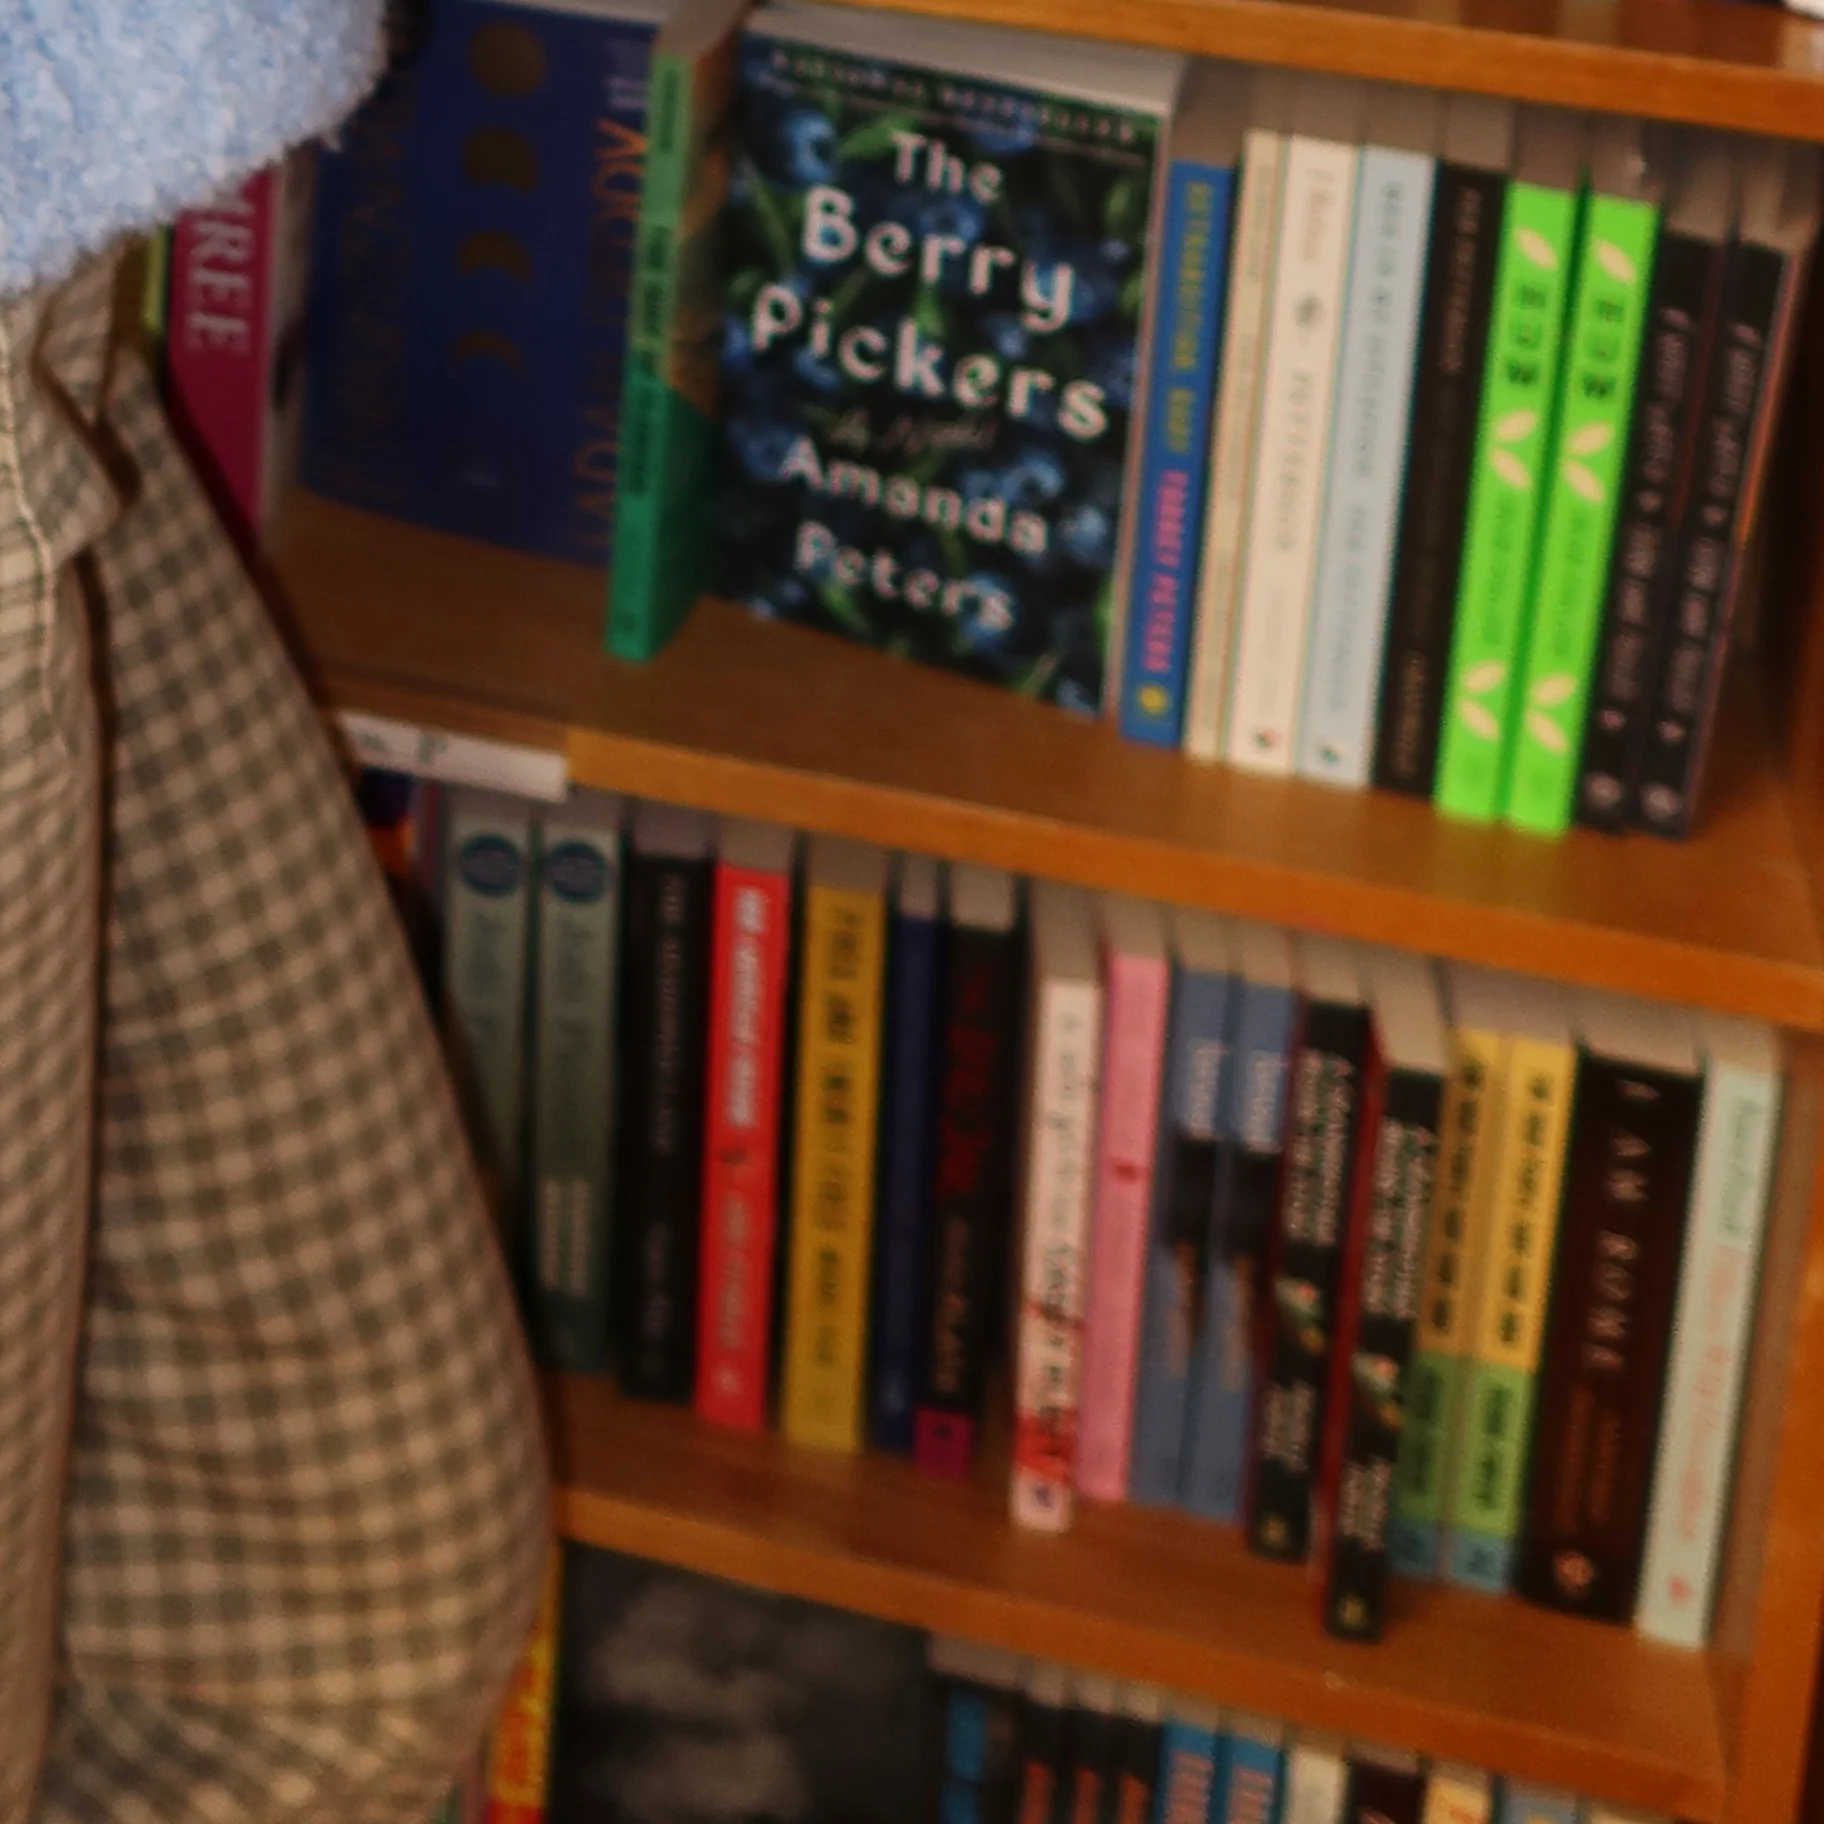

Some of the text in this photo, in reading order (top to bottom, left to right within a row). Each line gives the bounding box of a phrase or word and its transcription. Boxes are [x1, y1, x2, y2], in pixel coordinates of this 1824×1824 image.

[890, 126, 1004, 205] The
[804, 185, 1078, 333] Berry
[751, 282, 1107, 441] Pickers
[776, 436, 1051, 556] Amanda
[795, 519, 1019, 634] Peters
